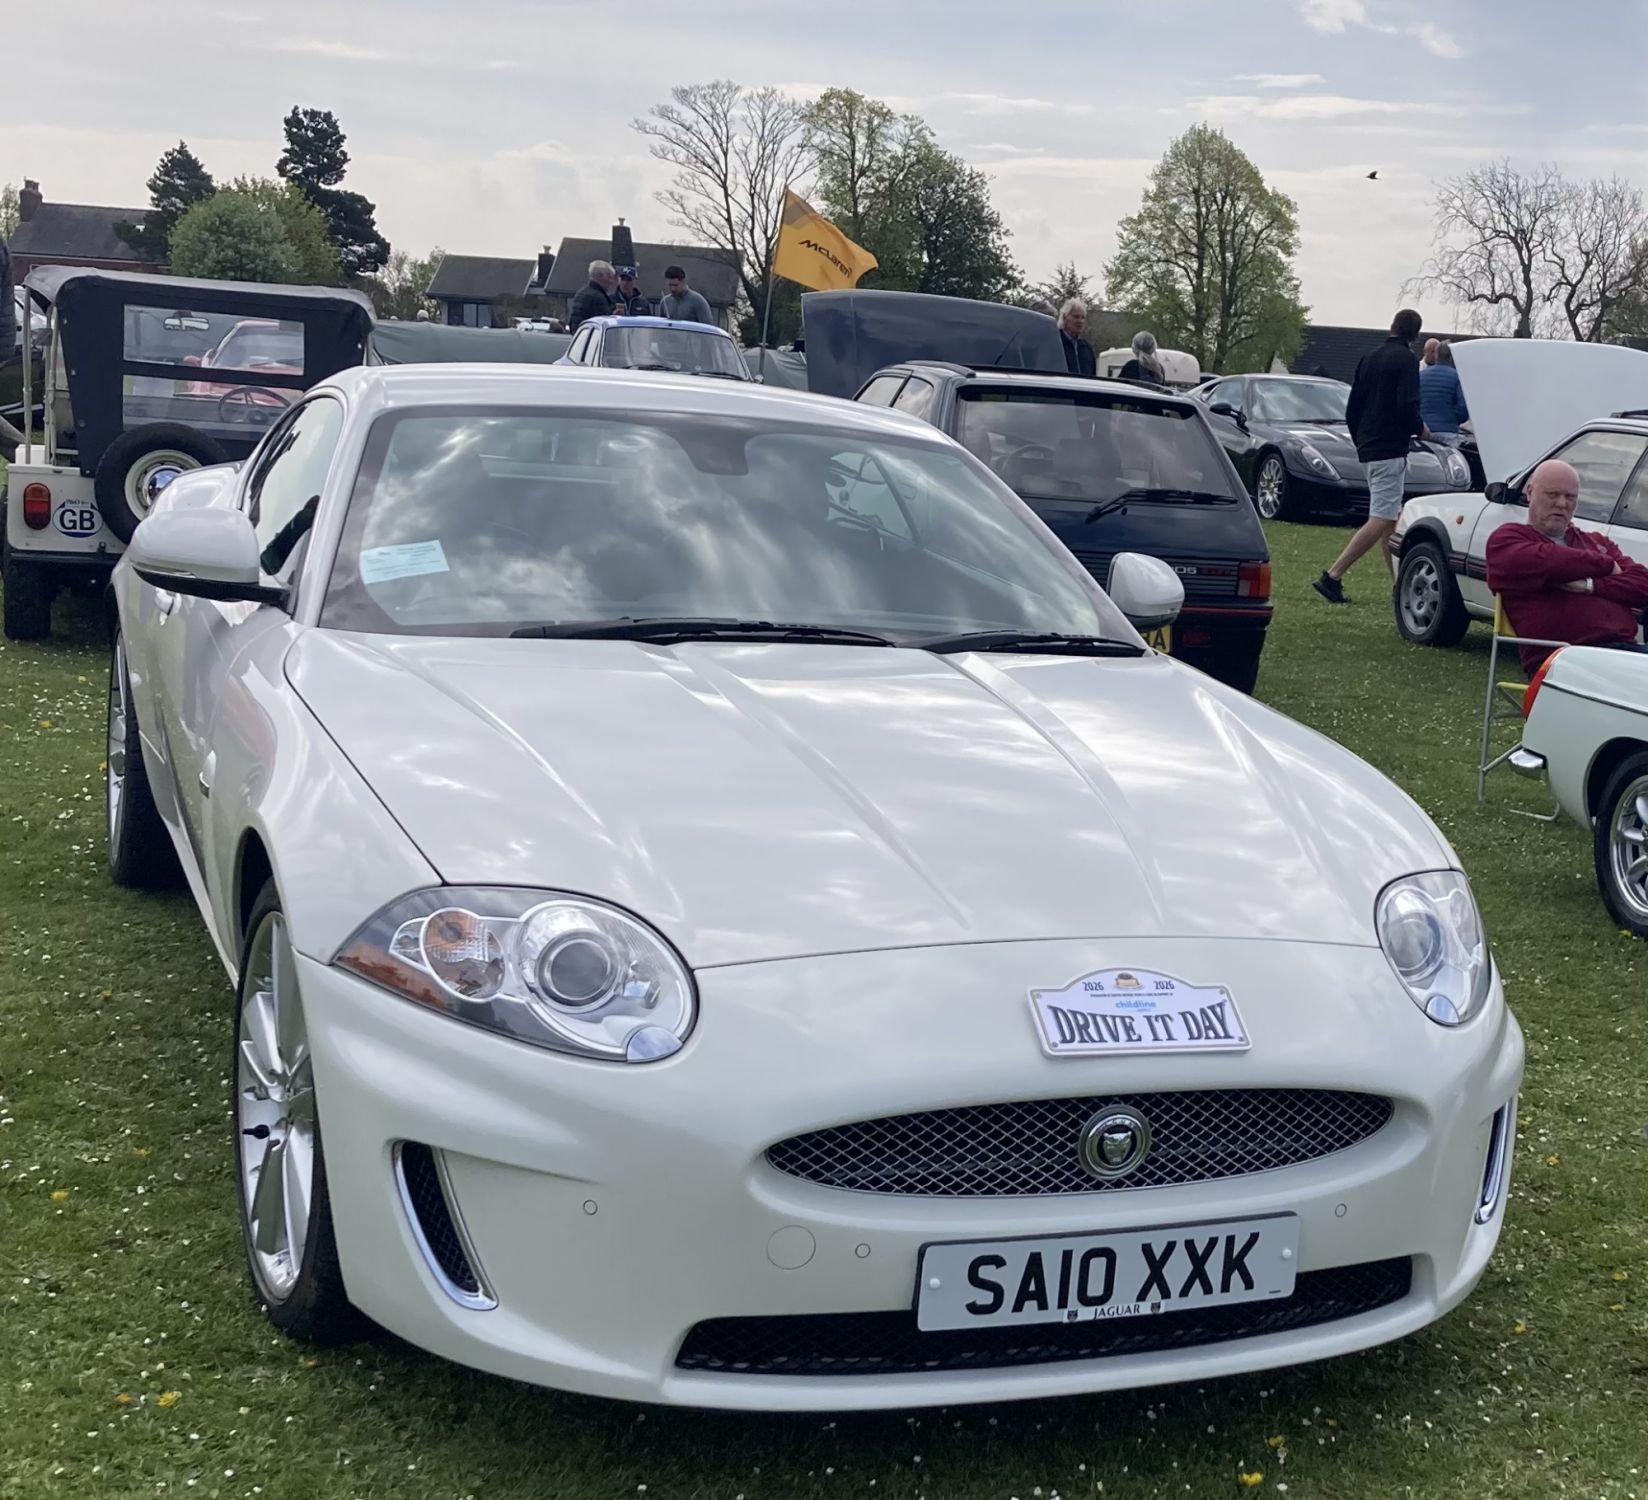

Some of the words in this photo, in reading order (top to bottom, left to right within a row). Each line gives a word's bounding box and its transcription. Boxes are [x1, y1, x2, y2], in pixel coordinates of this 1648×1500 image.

[798, 240, 851, 278] McLaren
[60, 509, 95, 530] GB
[1172, 566, 1198, 575] 05
[1082, 982, 1105, 992] 2026
[1155, 980, 1175, 990] 2026
[1115, 1000, 1156, 1009] childline
[1047, 1005, 1142, 1044] DRIVE
[1143, 1013, 1175, 1042] IT
[1178, 1001, 1235, 1041] DAY
[1136, 1231, 1260, 1302] XXK
[1093, 1303, 1141, 1321] JAGUAR
